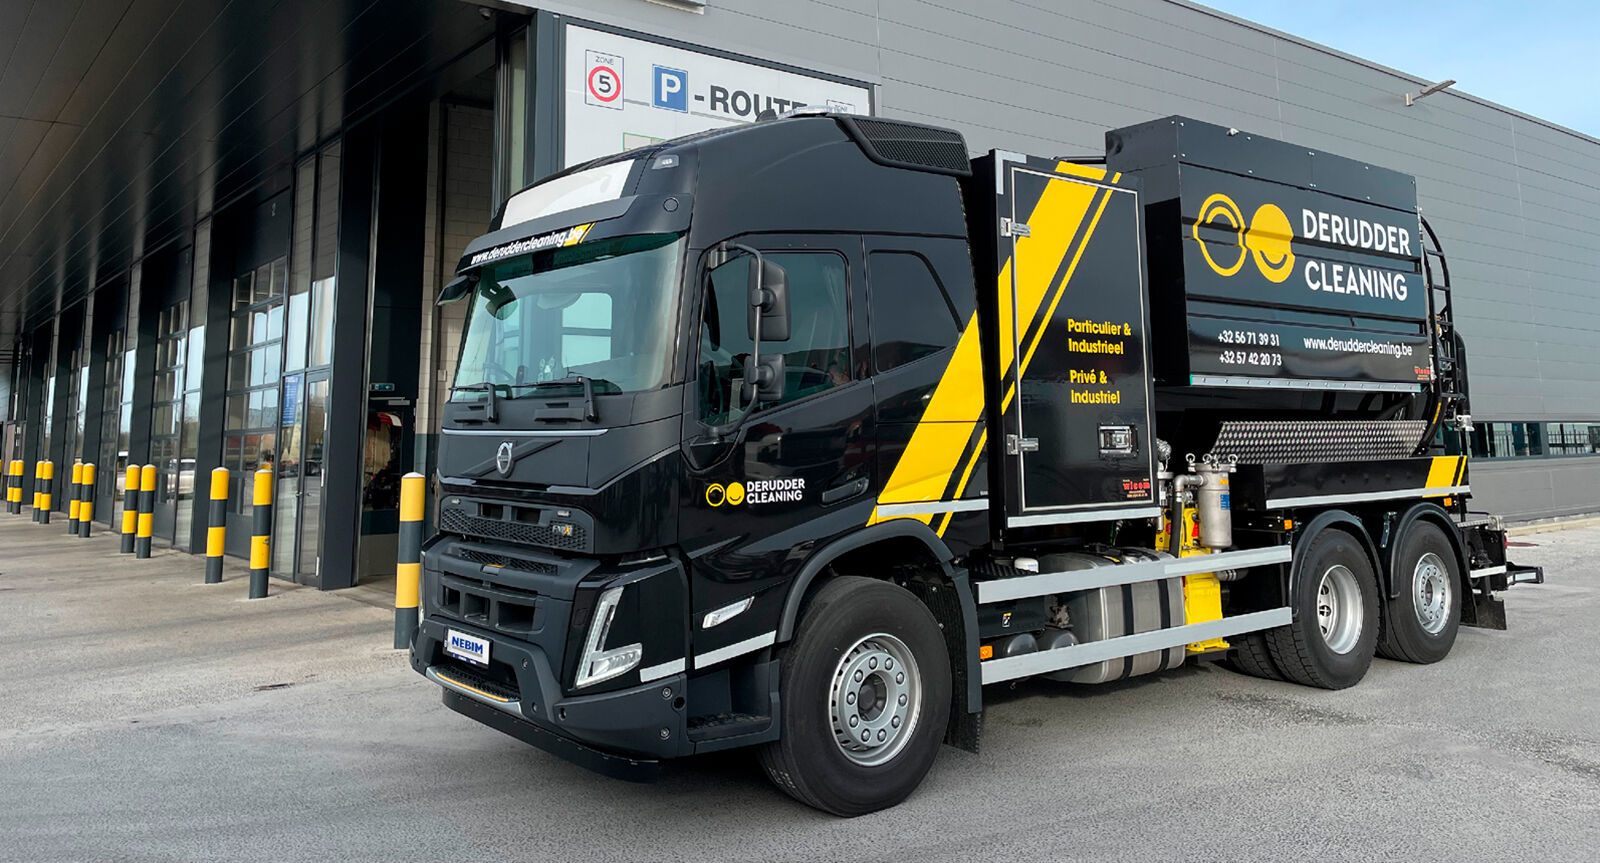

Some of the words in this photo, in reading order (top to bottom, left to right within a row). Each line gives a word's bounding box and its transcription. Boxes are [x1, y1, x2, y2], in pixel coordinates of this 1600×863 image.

[595, 55, 614, 66] ZONE
[599, 75, 611, 93] 5
[661, 73, 681, 102] P
[1302, 208, 1412, 256] DERUDDER
[470, 227, 585, 266] www.deruddercleaning.be
[1304, 260, 1408, 301] CLEANING
[1067, 318, 1122, 336] Particulier
[1123, 322, 1132, 336] &
[1068, 338, 1124, 355] Industrieel
[1218, 329, 1234, 344] +32
[1235, 331, 1246, 344] 56
[1246, 331, 1257, 345] 71
[1258, 333, 1269, 346] 39
[1270, 333, 1280, 347] 31
[1303, 336, 1413, 359] www.deruddercleaning.be
[1219, 350, 1235, 364] +32
[1236, 351, 1247, 365] 57
[1248, 352, 1259, 365] 42
[1260, 352, 1271, 366] 20
[1271, 353, 1282, 366] 73
[1069, 369, 1097, 384] Privé
[1100, 370, 1107, 384] &
[1071, 389, 1121, 404] Industriel
[746, 478, 806, 493] DERUDDER
[746, 490, 803, 505] CLEANING
[451, 635, 484, 655] NEBIM
